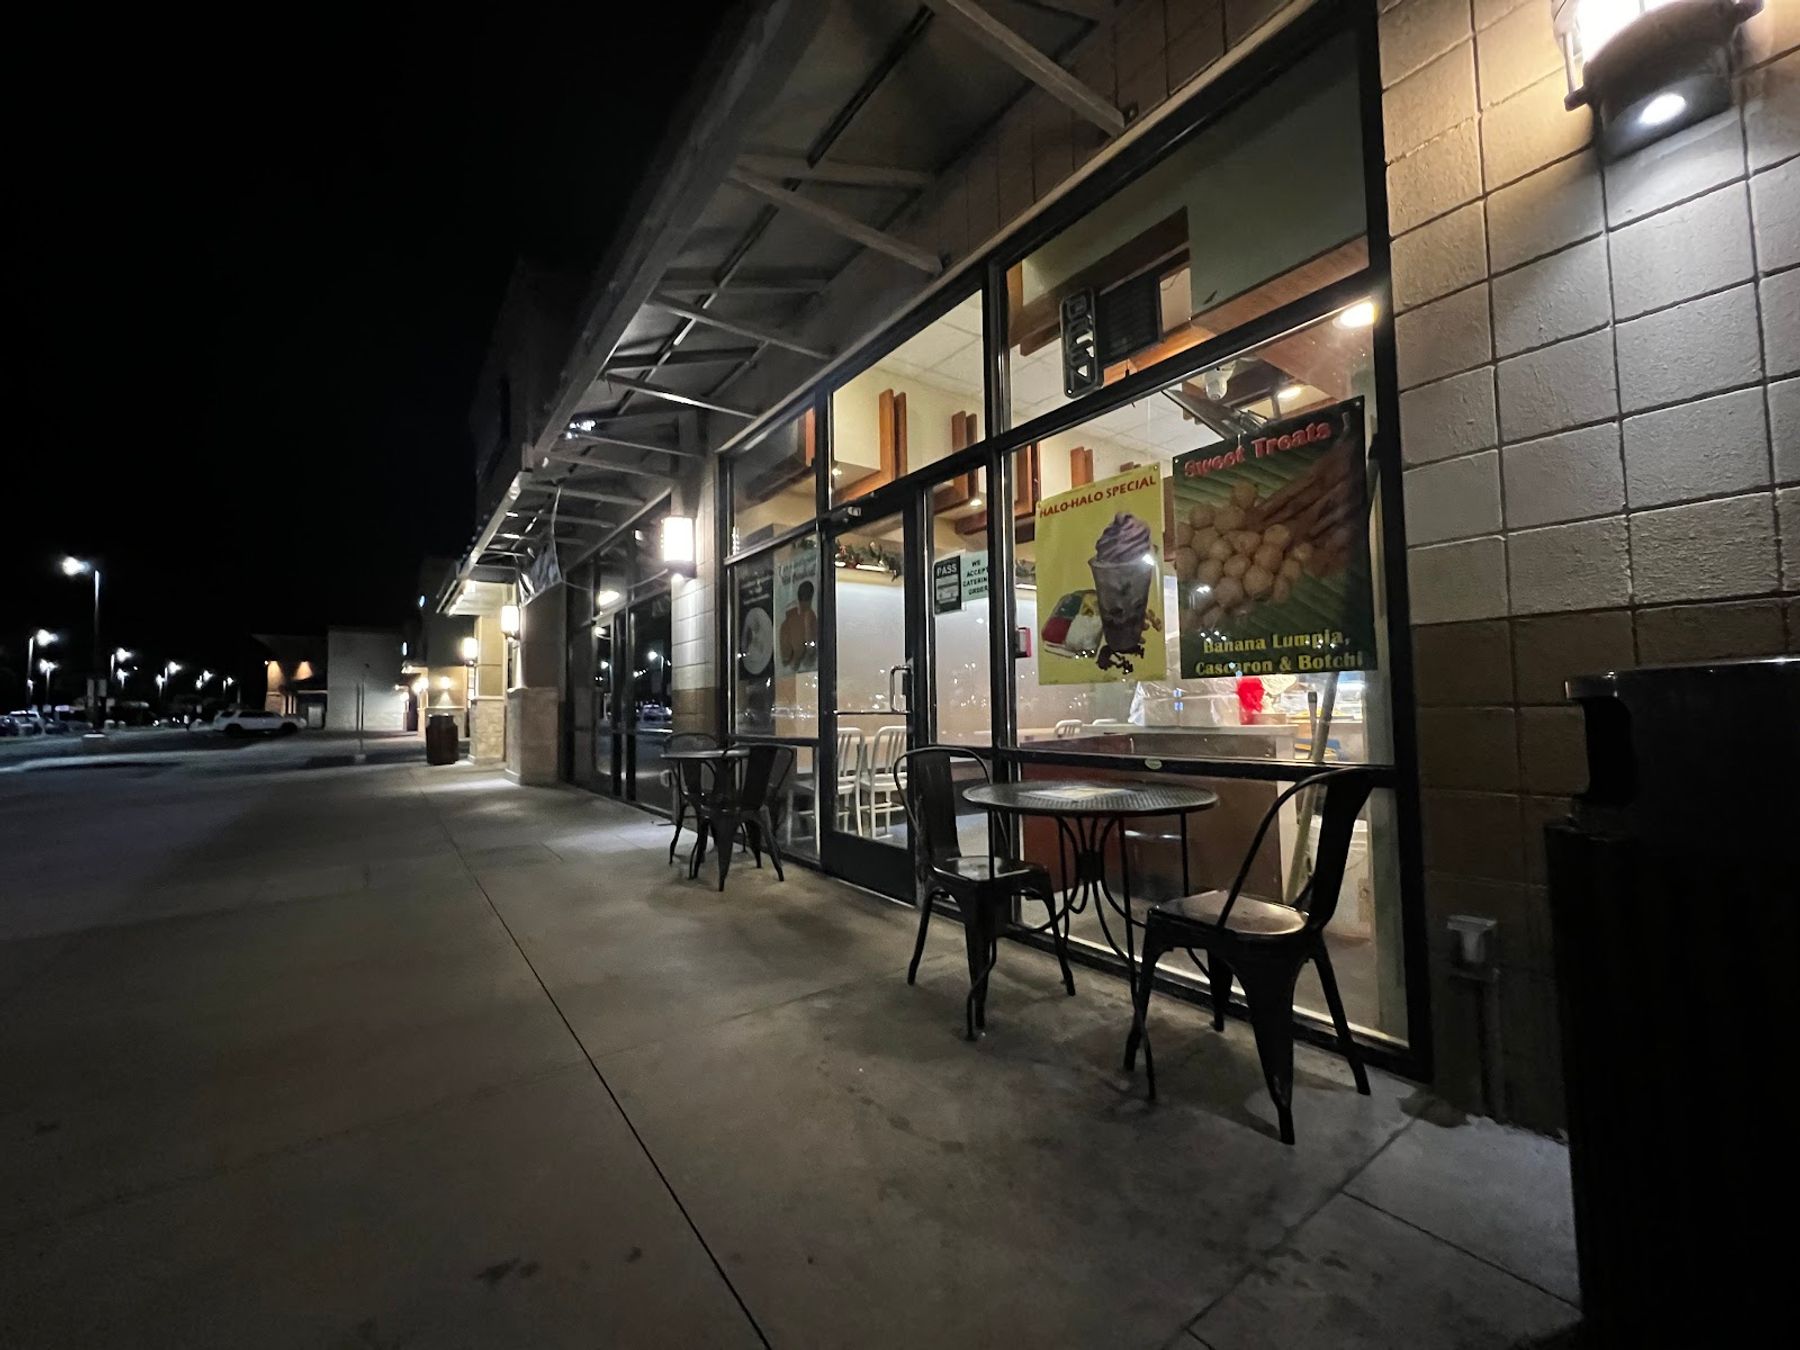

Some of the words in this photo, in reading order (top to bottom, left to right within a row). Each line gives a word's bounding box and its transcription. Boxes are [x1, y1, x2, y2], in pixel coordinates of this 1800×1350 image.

[1184, 446, 1246, 476] Sweet
[1251, 421, 1333, 459] Treats
[1040, 492, 1104, 518] HALO-HALO
[1106, 475, 1157, 498] SPECIAL
[937, 564, 957, 576] PASS
[963, 576, 988, 587] CATERIN
[1203, 638, 1267, 654] Banana
[1272, 628, 1351, 650] Lumpia,
[1279, 656, 1292, 671] &
[1298, 651, 1363, 671] Botchi
